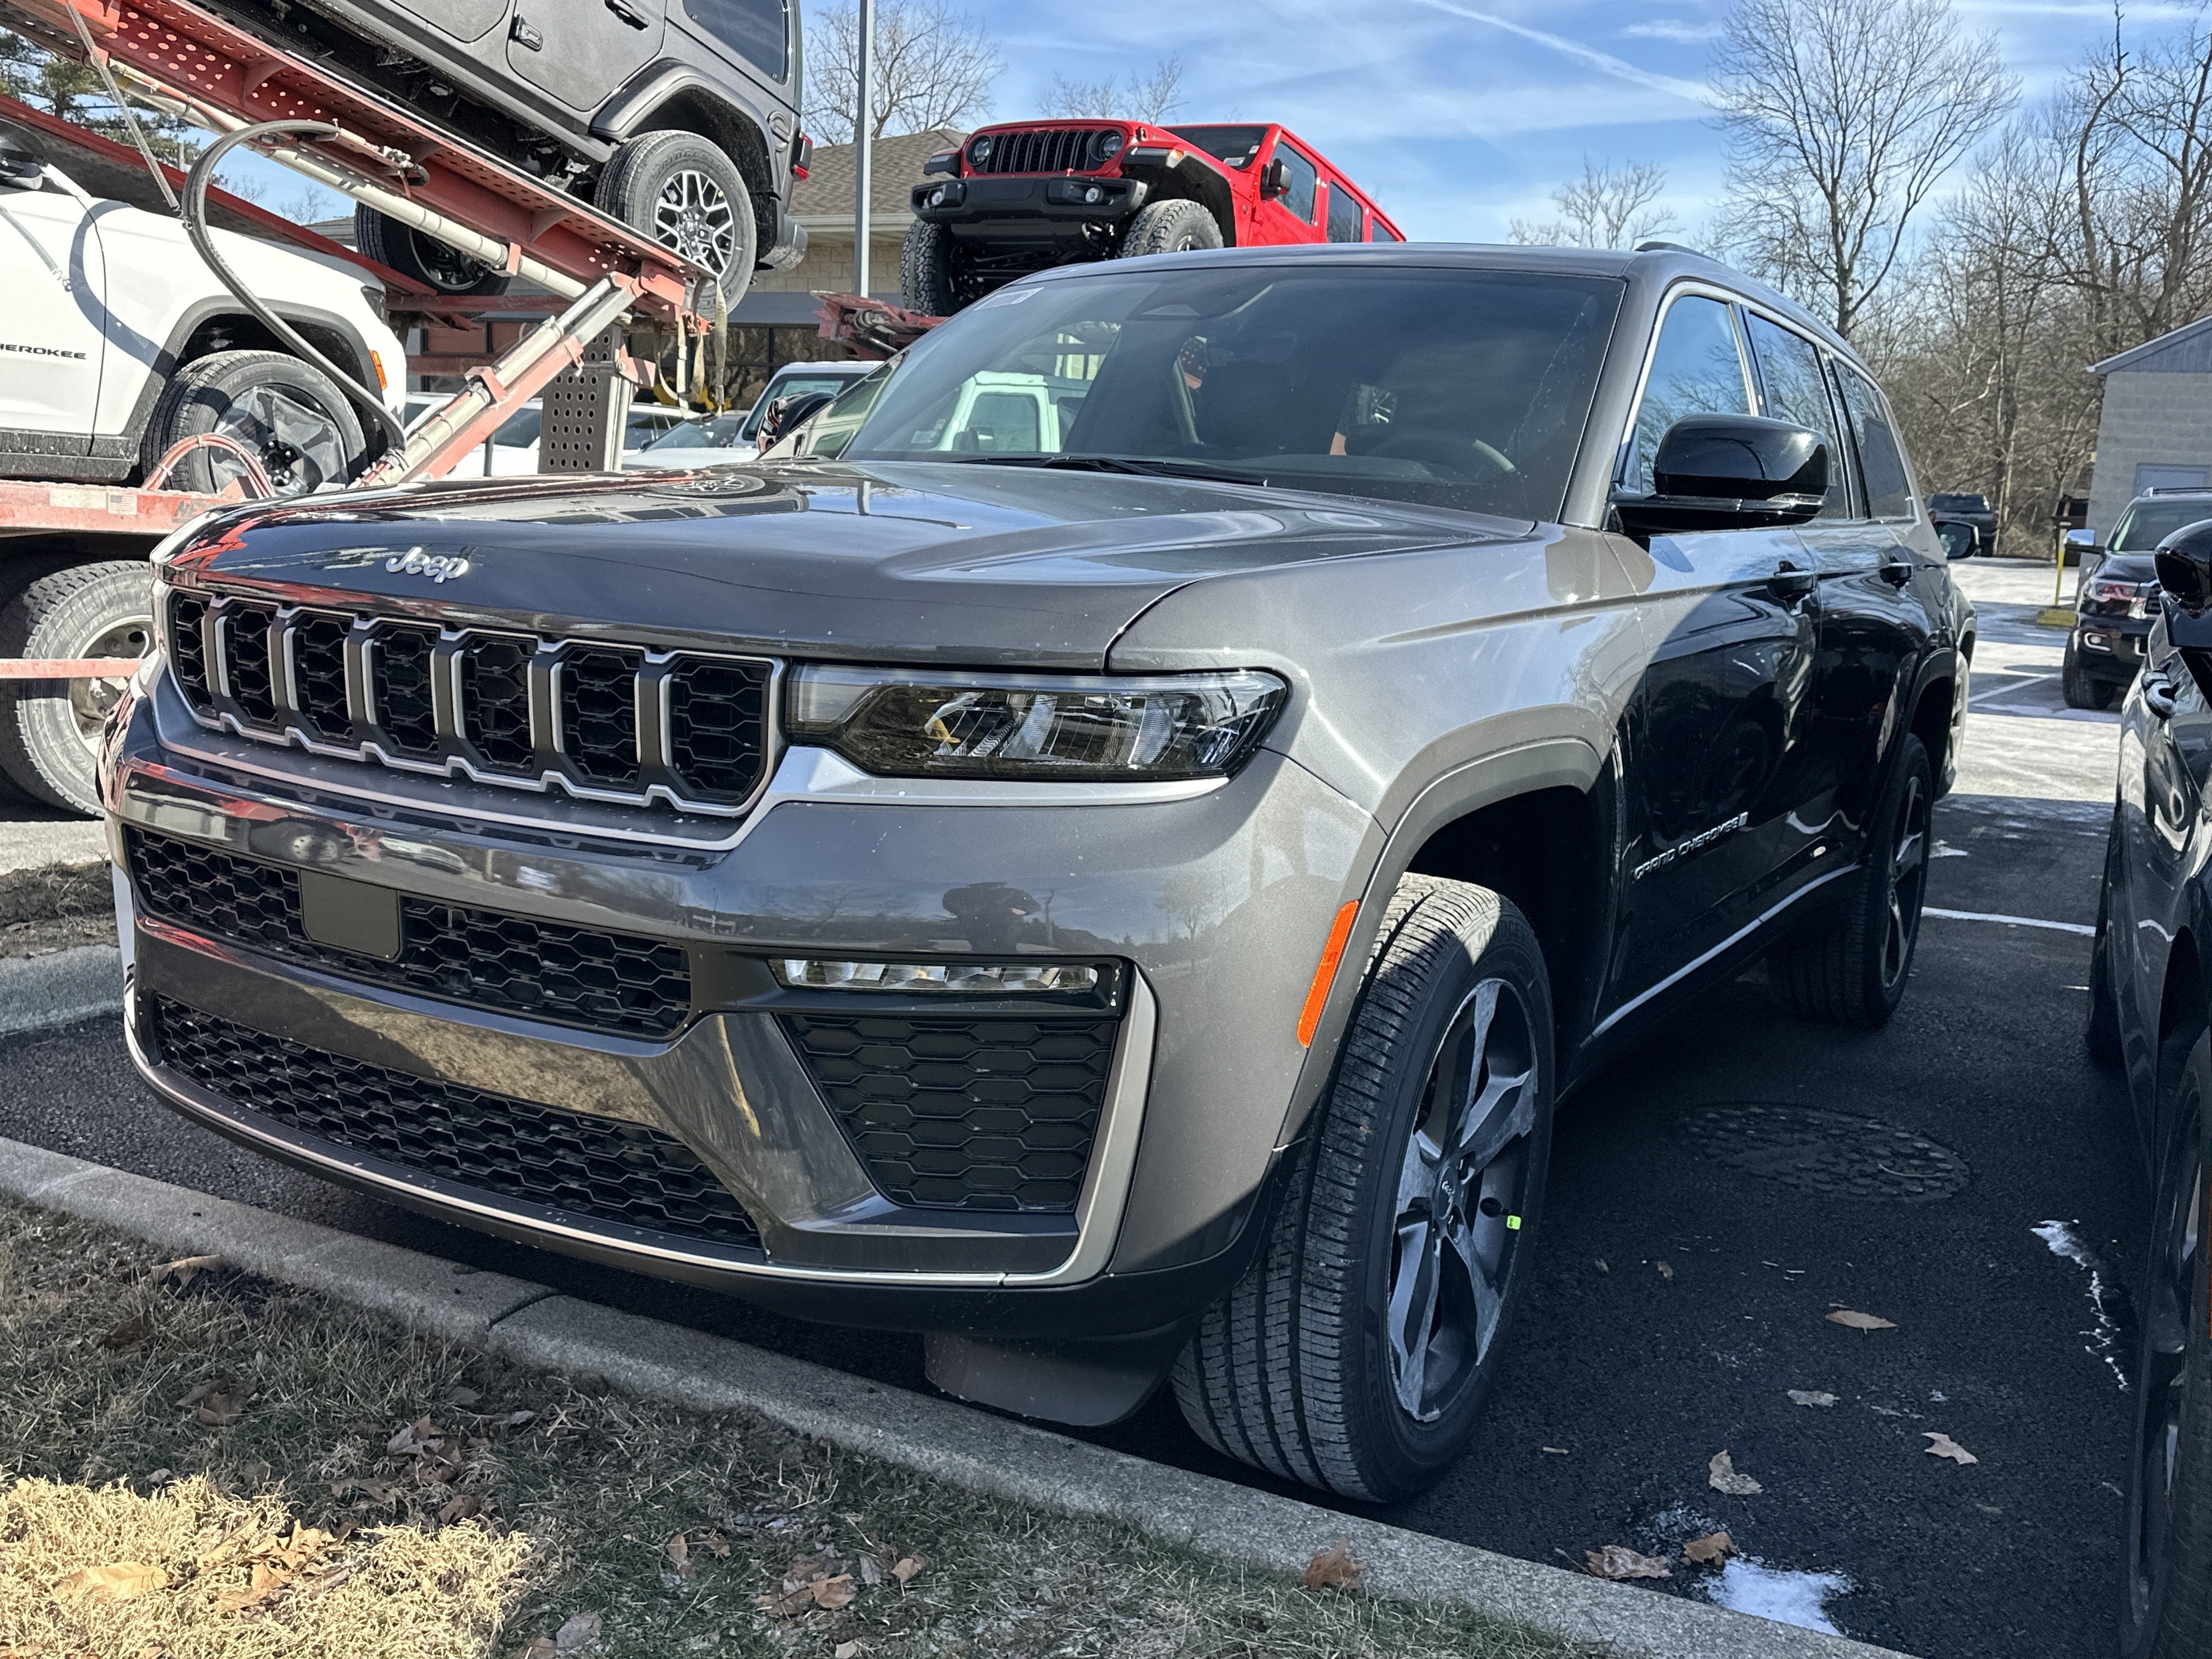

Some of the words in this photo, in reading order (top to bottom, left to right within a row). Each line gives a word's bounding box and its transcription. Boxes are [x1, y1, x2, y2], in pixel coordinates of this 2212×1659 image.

[385, 546, 469, 583] Jeep
[1634, 848, 1676, 880] GRAND
[1678, 816, 1739, 856] CHEROKEE
